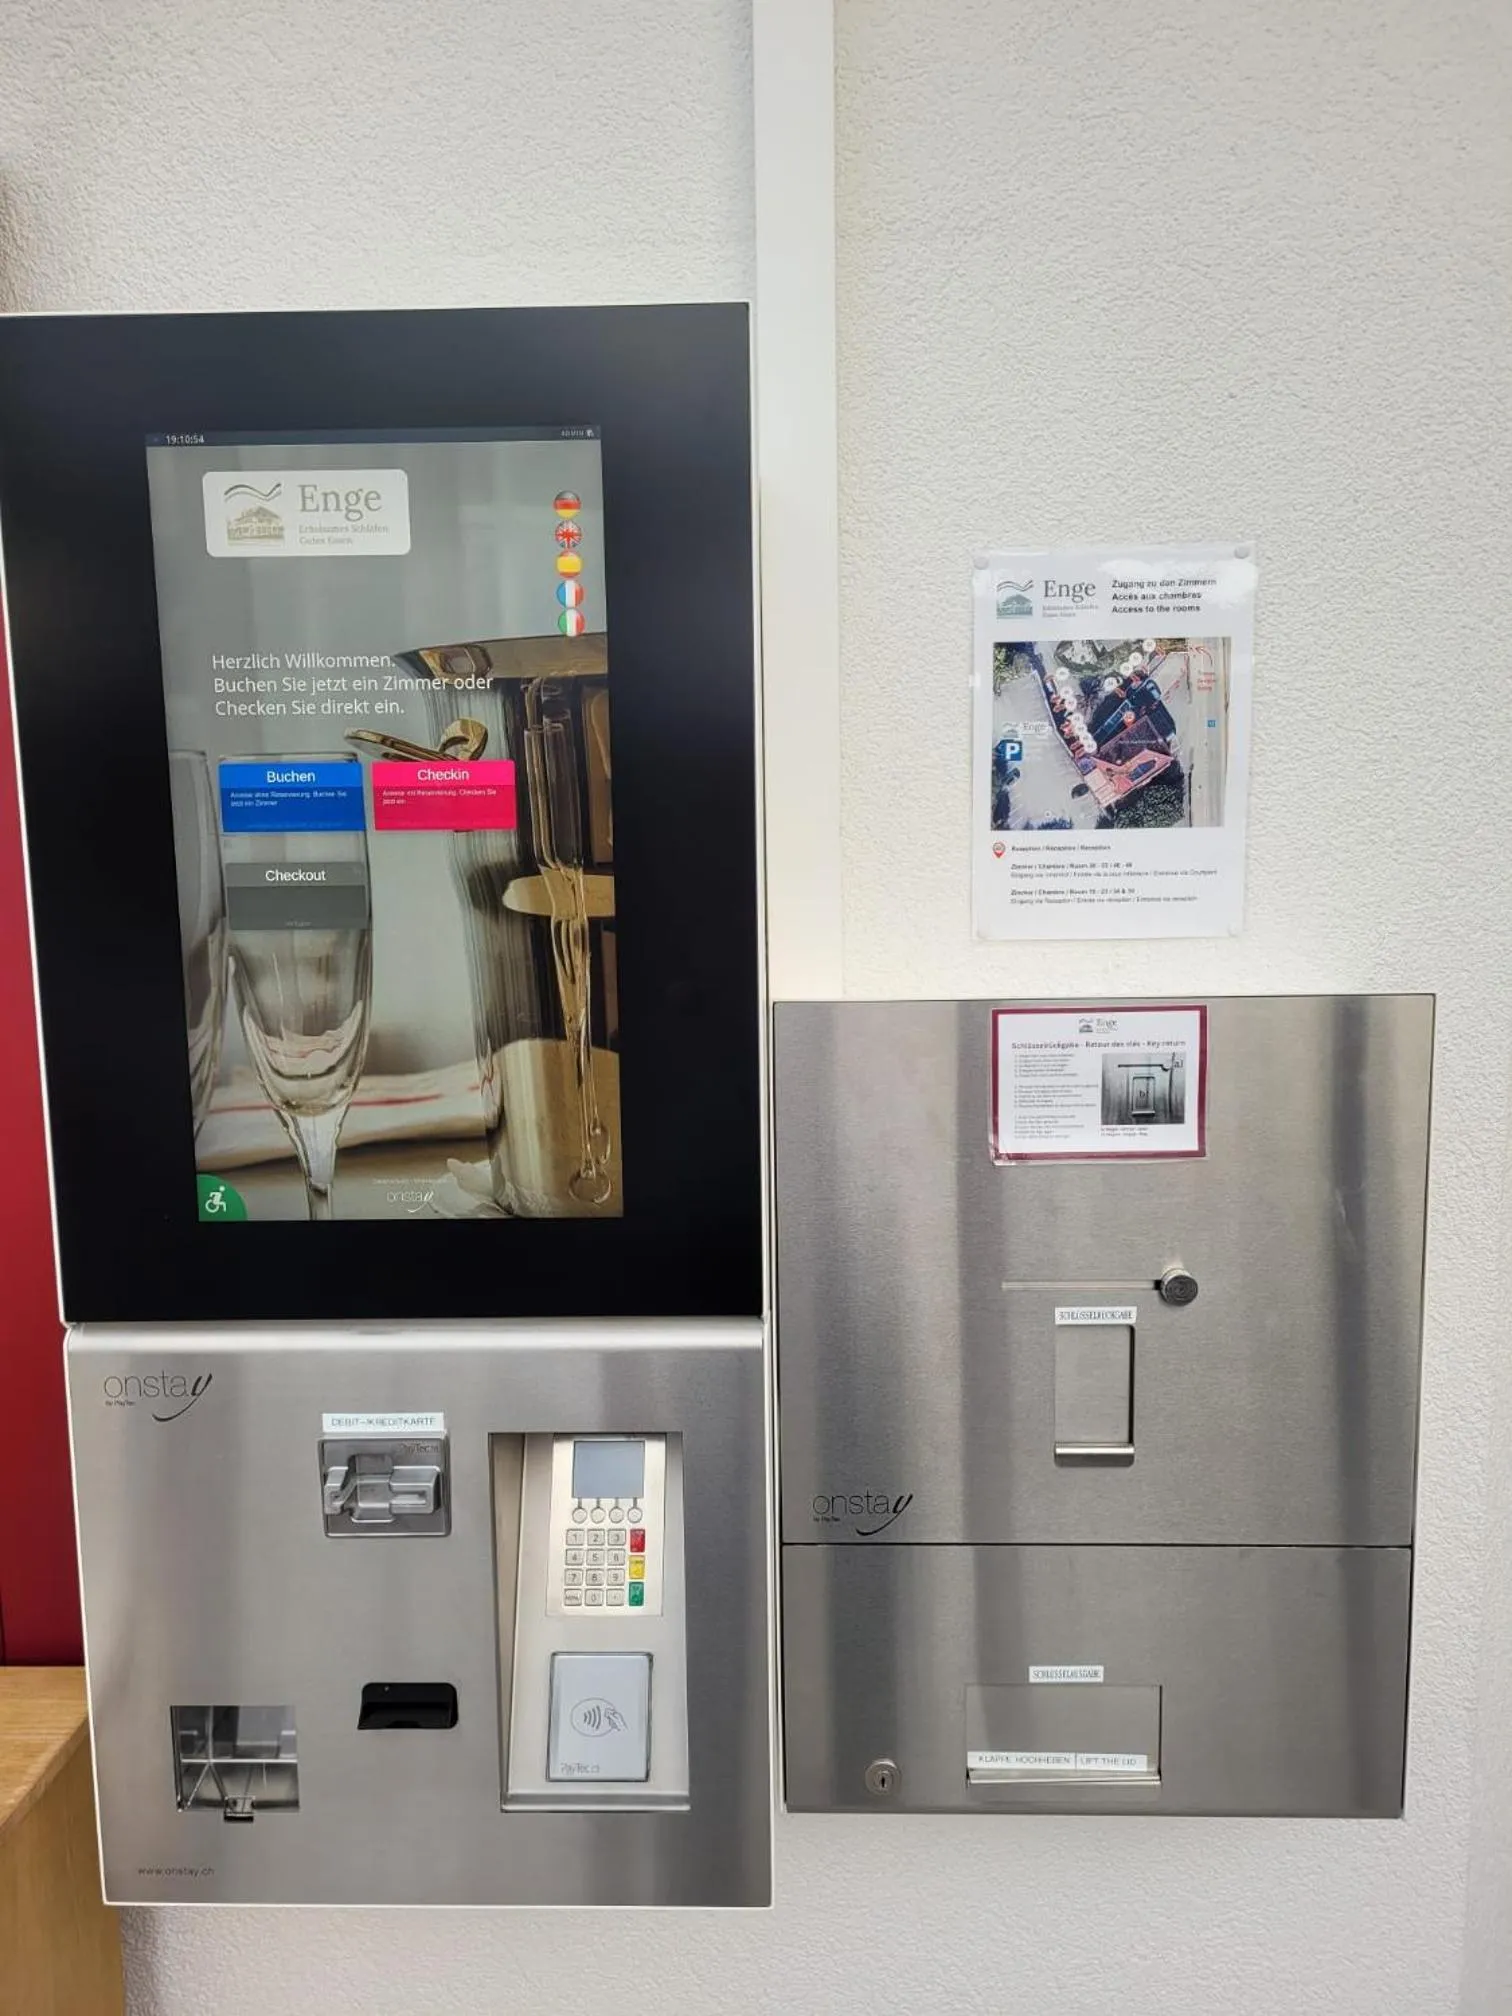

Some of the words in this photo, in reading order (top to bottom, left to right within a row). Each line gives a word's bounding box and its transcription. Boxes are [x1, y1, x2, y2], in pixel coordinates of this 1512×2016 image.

[166, 434, 204, 445] 19:10:54
[297, 484, 383, 522] Enge
[1112, 579, 1145, 589] Zugang
[1044, 580, 1096, 604] Enge
[1112, 605, 1143, 613] Access
[1145, 605, 1154, 613] to
[1156, 604, 1170, 612] the
[1172, 604, 1200, 612] rooms
[212, 653, 280, 670] Herzlich
[284, 651, 396, 669] Willkommen.
[214, 677, 277, 693] Buchen
[282, 676, 307, 692] Sie
[311, 676, 348, 696] jetzt
[352, 676, 379, 691] ein
[383, 675, 447, 691] Zimmer
[453, 674, 494, 690] oder
[215, 700, 286, 716] Checken
[291, 699, 316, 715] Sie
[321, 698, 370, 714] direkt
[374, 699, 405, 714] ein.
[1005, 742, 1020, 759] P
[266, 770, 316, 783] Buchen
[417, 768, 470, 781] Checkin
[265, 868, 327, 881] Checkout
[104, 1369, 212, 1422] onstay
[812, 1488, 913, 1536] onstay
[592, 1533, 599, 1543] 2
[571, 1552, 578, 1562] 4
[591, 1552, 598, 1562] 5
[1102, 1758, 1119, 1766] THE
[138, 1867, 215, 1879] www.onstay.ch
